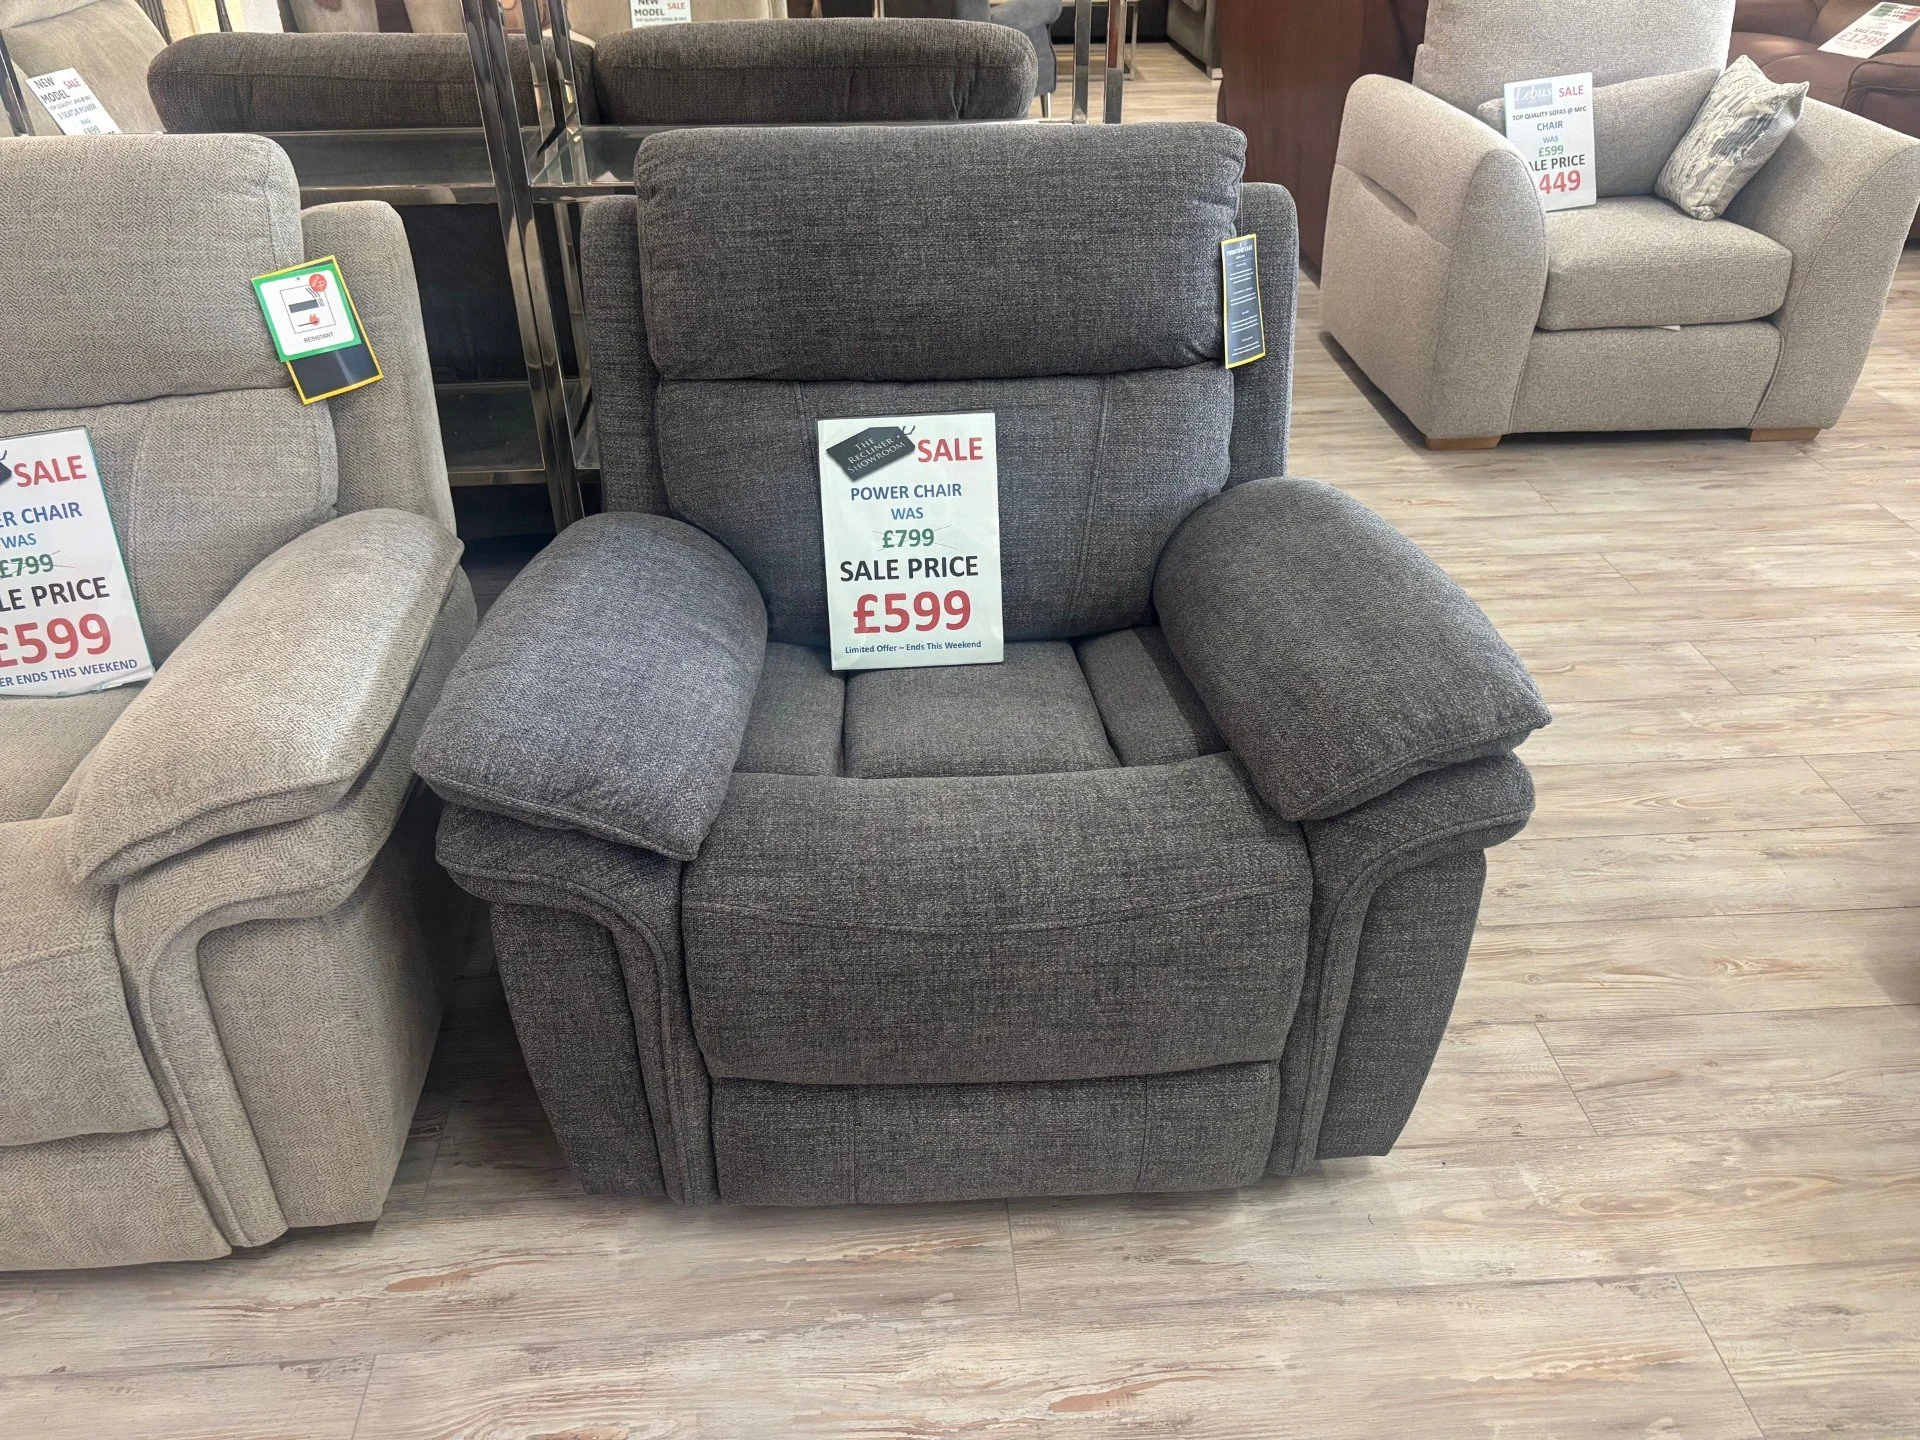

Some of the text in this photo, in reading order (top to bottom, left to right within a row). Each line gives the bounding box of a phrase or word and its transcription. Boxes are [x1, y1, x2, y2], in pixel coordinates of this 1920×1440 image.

[634, 8, 665, 16] MODEL
[1836, 31, 1886, 46] £1299
[34, 76, 55, 89] NEW
[63, 78, 82, 90] SALE
[40, 90, 70, 104] MODEL
[1515, 85, 1584, 101] Lebus SALE
[79, 104, 97, 114] POWER
[1524, 112, 1548, 120] QUALITY
[1536, 120, 1563, 131] CHAIR
[1538, 145, 1564, 157] £599
[1529, 154, 1586, 172] LE PRICE
[1539, 170, 1581, 194] 449
[304, 332, 334, 344] RESISTANT
[847, 438, 983, 464] RECLINER SALE
[854, 438, 876, 450] THE
[847, 442, 906, 474] SHOWROOM
[14, 455, 86, 488] SALE
[850, 484, 962, 500] POWER CHAIR
[22, 502, 82, 524] CHAIR
[891, 508, 924, 520] WAS
[0, 533, 36, 548] WAS
[882, 528, 934, 548] £799
[0, 554, 54, 578] £799
[840, 556, 978, 582] SALE PRICE
[0, 576, 110, 612] LE PRICE
[854, 590, 971, 634] £599
[0, 614, 112, 668] £599
[846, 645, 874, 654] Limited
[877, 644, 897, 652] Offer
[906, 643, 925, 651] Ends
[927, 642, 943, 650] This
[945, 640, 982, 650] Weekend
[18, 672, 48, 684] ENDS
[50, 666, 76, 679] THIS
[78, 659, 138, 676] WEEKEND
